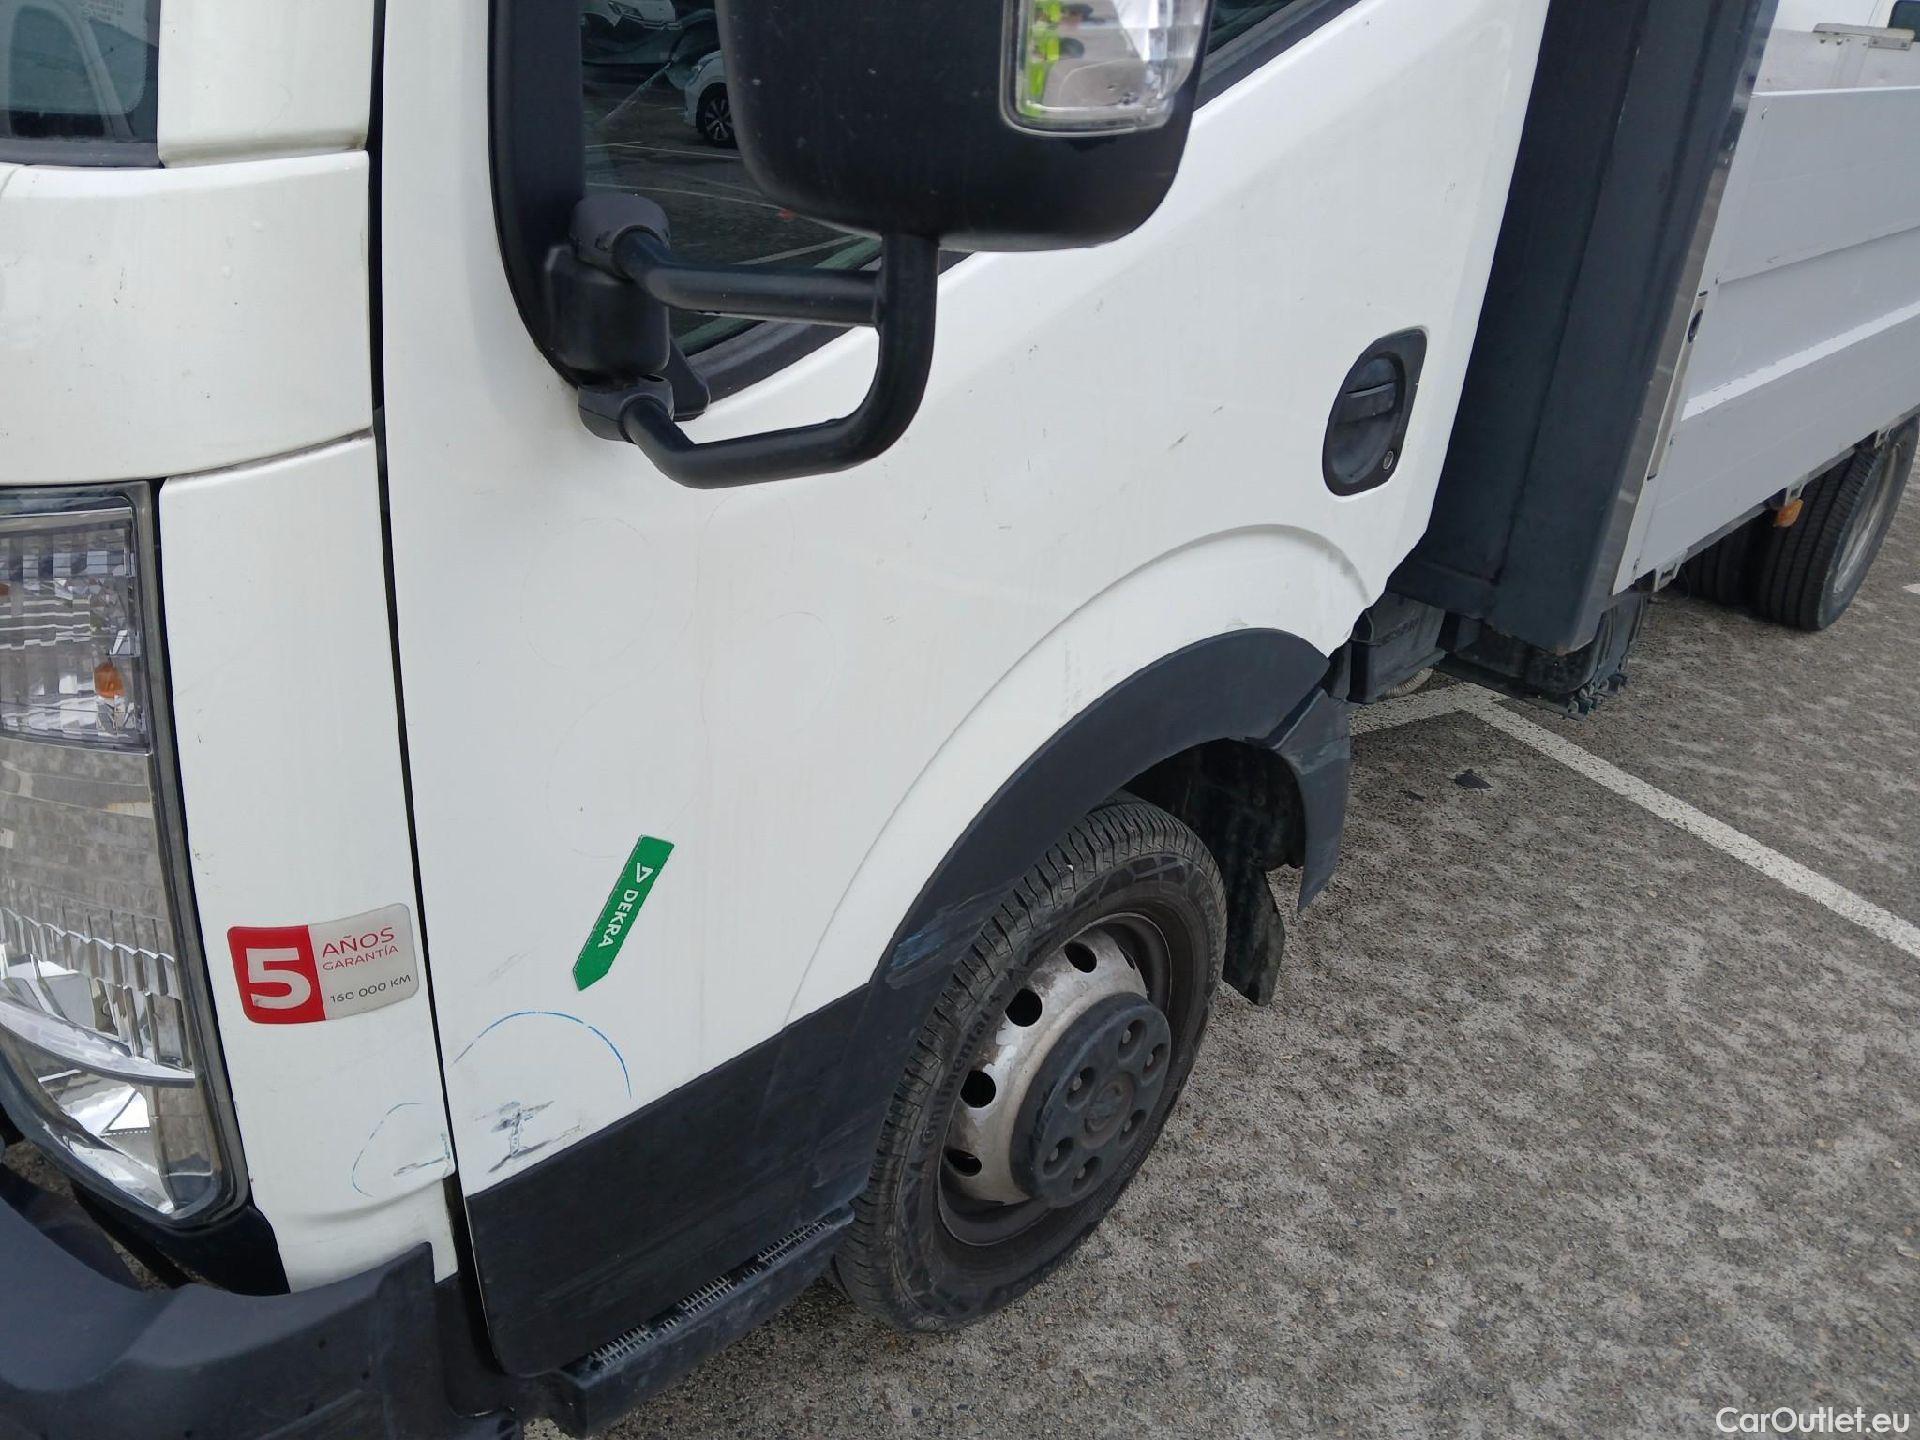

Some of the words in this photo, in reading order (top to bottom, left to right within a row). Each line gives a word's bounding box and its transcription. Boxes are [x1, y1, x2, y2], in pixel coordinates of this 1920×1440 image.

[598, 889, 639, 948] DEKRA
[322, 927, 395, 957] AÑOS
[322, 945, 399, 971] GARANTÍA
[245, 946, 312, 1010] 5
[358, 982, 386, 998] 000
[390, 974, 411, 988] KM
